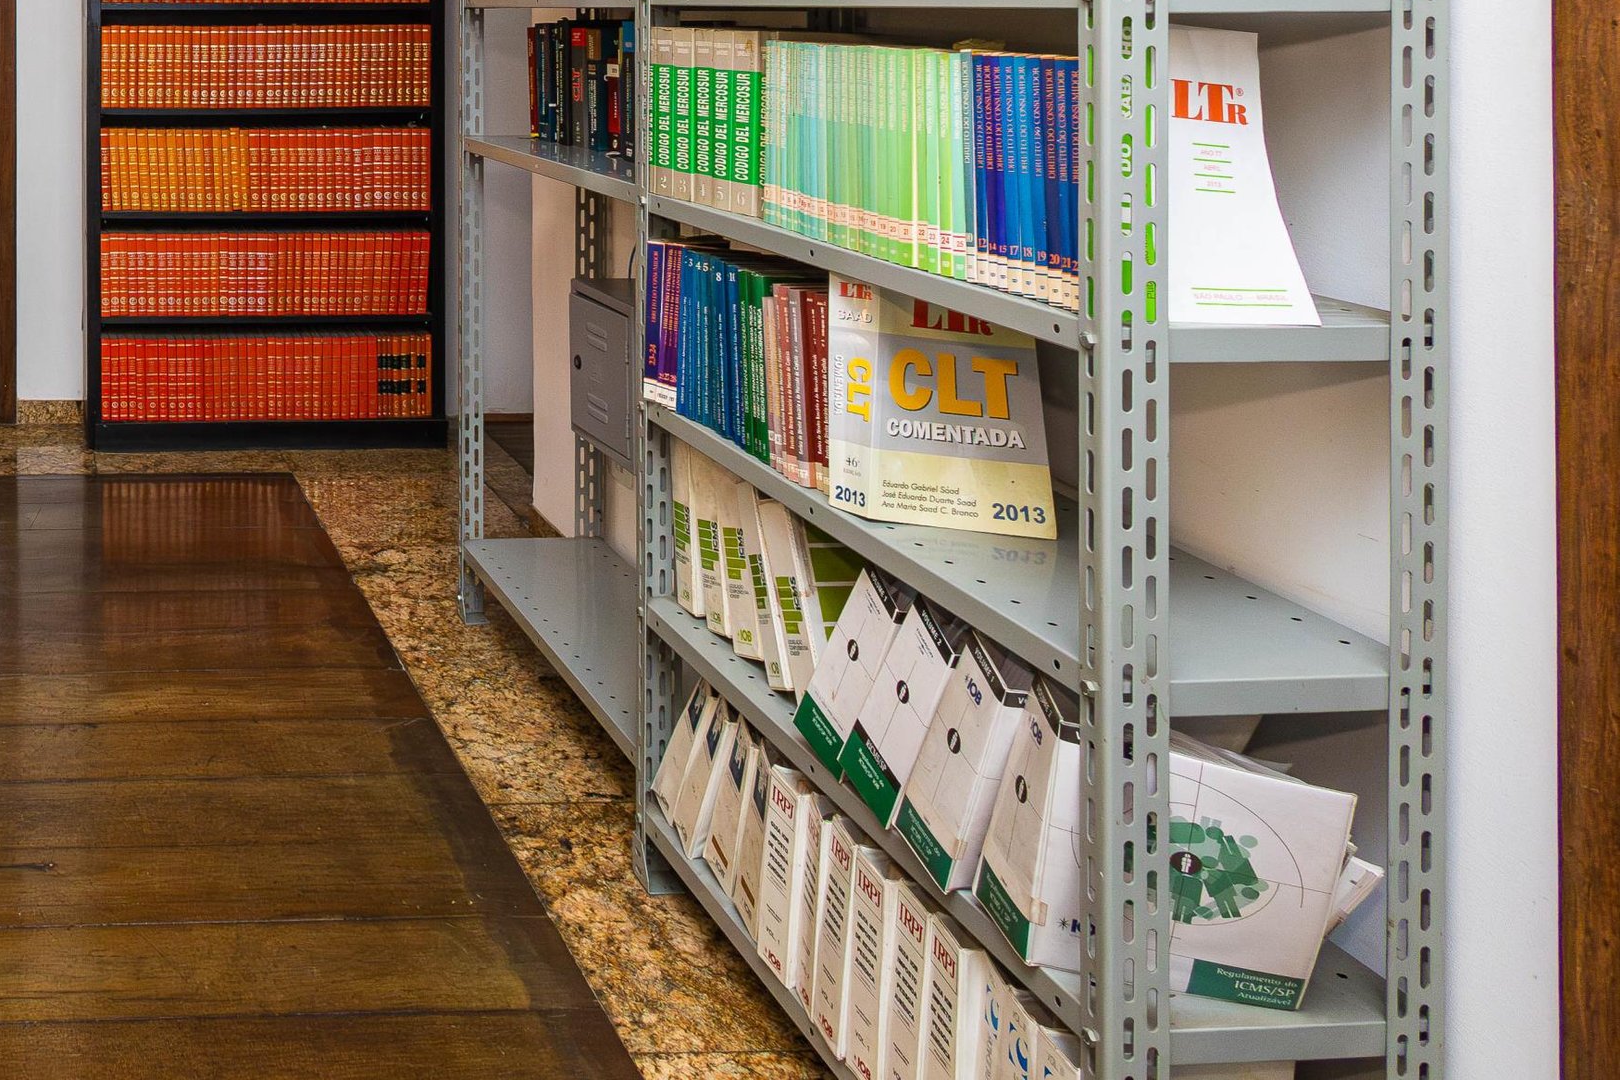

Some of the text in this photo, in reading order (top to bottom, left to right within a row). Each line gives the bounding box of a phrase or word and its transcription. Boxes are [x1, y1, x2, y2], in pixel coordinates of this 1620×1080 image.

[1032, 67, 1040, 125] CONSUMIDOR
[658, 66, 671, 166] CODIGO DEL MERCOSUR
[676, 69, 689, 170] CODIGO DEL MERCOSUR
[697, 69, 710, 172] CODIGO DEL MERCOSUR
[715, 71, 728, 177] CODIGO DEL MERCOSUR
[734, 73, 750, 181] CODIGO DEL MERCOSUR
[963, 116, 969, 130] DO
[1045, 68, 1056, 179] DIREITO DO CONSUMIDOR
[1056, 69, 1068, 182] DIREITO DO CONSUMIDOR
[1034, 126, 1041, 140] DO
[659, 175, 668, 189] 2
[940, 236, 950, 245] 24
[978, 238, 987, 248] 12
[1009, 245, 1019, 256] 17
[1023, 247, 1033, 257] 18
[702, 262, 709, 272] 5
[1037, 251, 1046, 261] 19
[1049, 254, 1060, 264] 20
[1062, 257, 1071, 268] 21
[715, 272, 722, 282] 8
[838, 309, 873, 324] SAAD
[649, 344, 657, 366] 23-24
[833, 353, 844, 415] COMENTADA
[846, 356, 873, 423] CLT
[888, 347, 1020, 421] CLT
[886, 418, 1027, 450] COMENTADA
[835, 485, 866, 508] 2013
[882, 479, 910, 490] Eduardo
[910, 483, 939, 493] Gabriel
[881, 490, 977, 508] José Eduardo Duarte Saad
[881, 500, 895, 509] Ana
[896, 502, 917, 511] Maria
[919, 504, 938, 514] Saad
[951, 507, 979, 518] Branco
[991, 502, 1047, 524] 2013
[710, 521, 720, 552] ICMS
[736, 527, 746, 560] ICMS
[789, 576, 801, 611] ICMS
[921, 610, 938, 640] VOLUME
[966, 678, 982, 706] IOB
[772, 784, 794, 820] IRPJ
[831, 835, 850, 872] IRPJ
[858, 868, 881, 909] IRPJ
[898, 901, 924, 944] IRPJ
[932, 934, 957, 980] IRPJ
[1216, 967, 1299, 988] Regulamento do
[1233, 980, 1295, 997] ICMS/SP
[1237, 991, 1292, 1006] Atualizável
